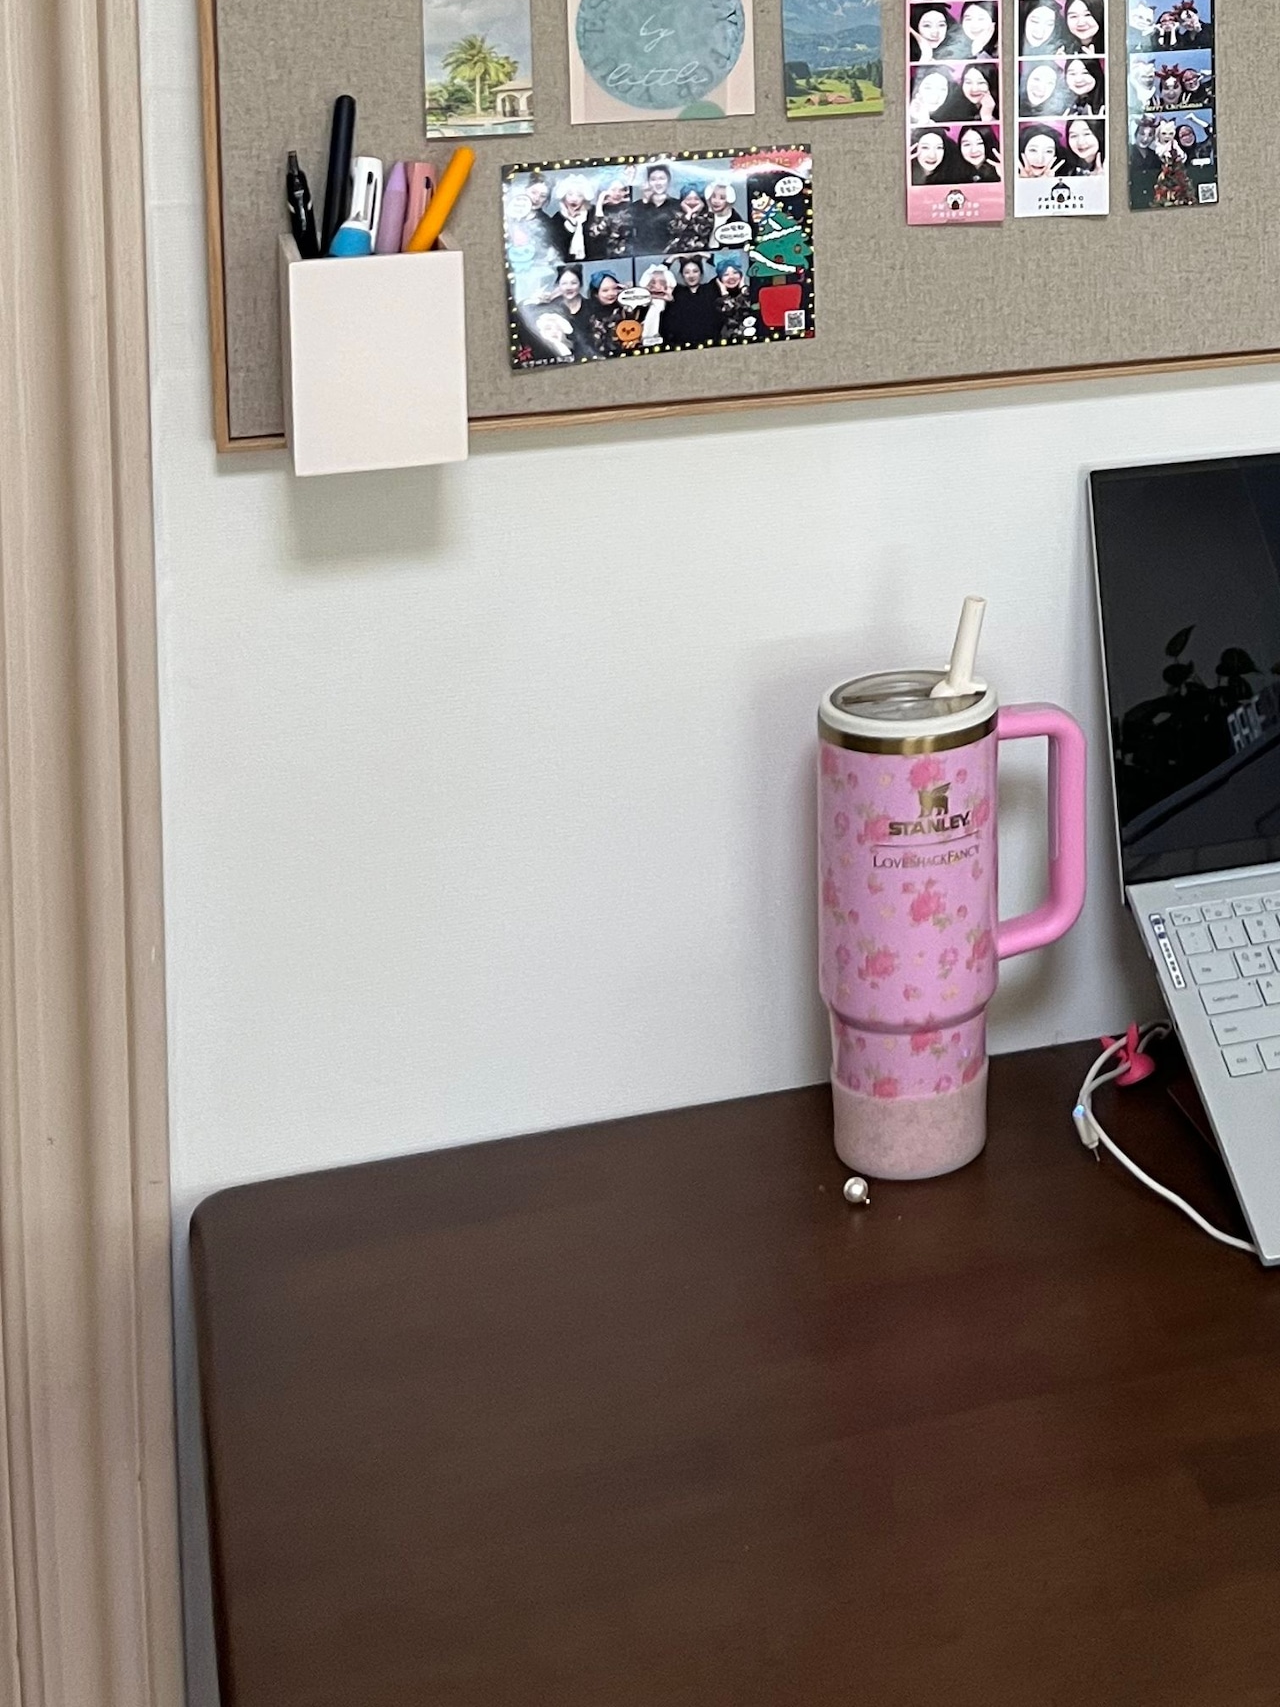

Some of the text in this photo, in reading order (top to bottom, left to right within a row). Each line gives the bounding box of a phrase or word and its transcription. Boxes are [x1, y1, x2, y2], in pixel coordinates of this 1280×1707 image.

[640, 14, 676, 53] by
[606, 61, 708, 87] little
[1038, 203, 1085, 211] FRIENDS
[889, 810, 970, 836] STANLEY
